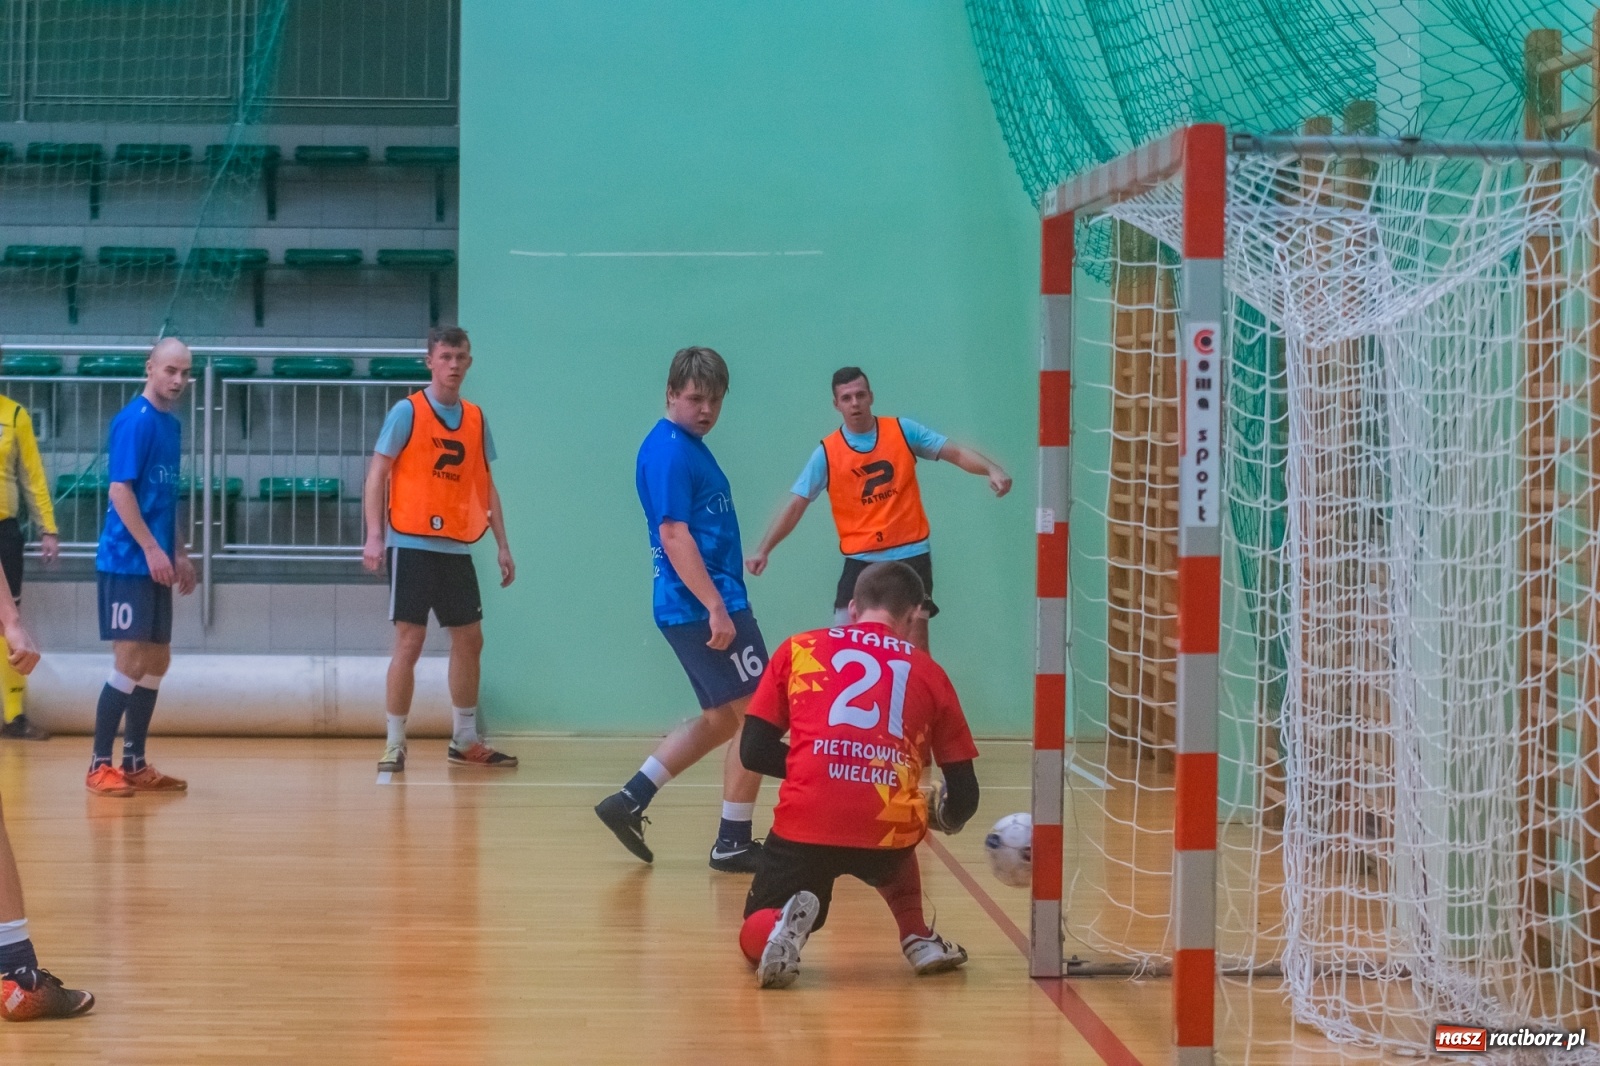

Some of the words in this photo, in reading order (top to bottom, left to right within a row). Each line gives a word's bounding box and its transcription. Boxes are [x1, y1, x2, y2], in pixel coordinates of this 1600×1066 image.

[432, 469, 461, 482] PATRICK
[1196, 429, 1210, 522] sport
[861, 487, 899, 506] PATRICK
[431, 515, 443, 530] 9
[875, 531, 884, 543] 3
[111, 602, 133, 630] 10
[828, 627, 915, 656] START
[730, 645, 764, 683] 16
[827, 648, 912, 740] 21
[828, 763, 898, 787] WIELKIE
